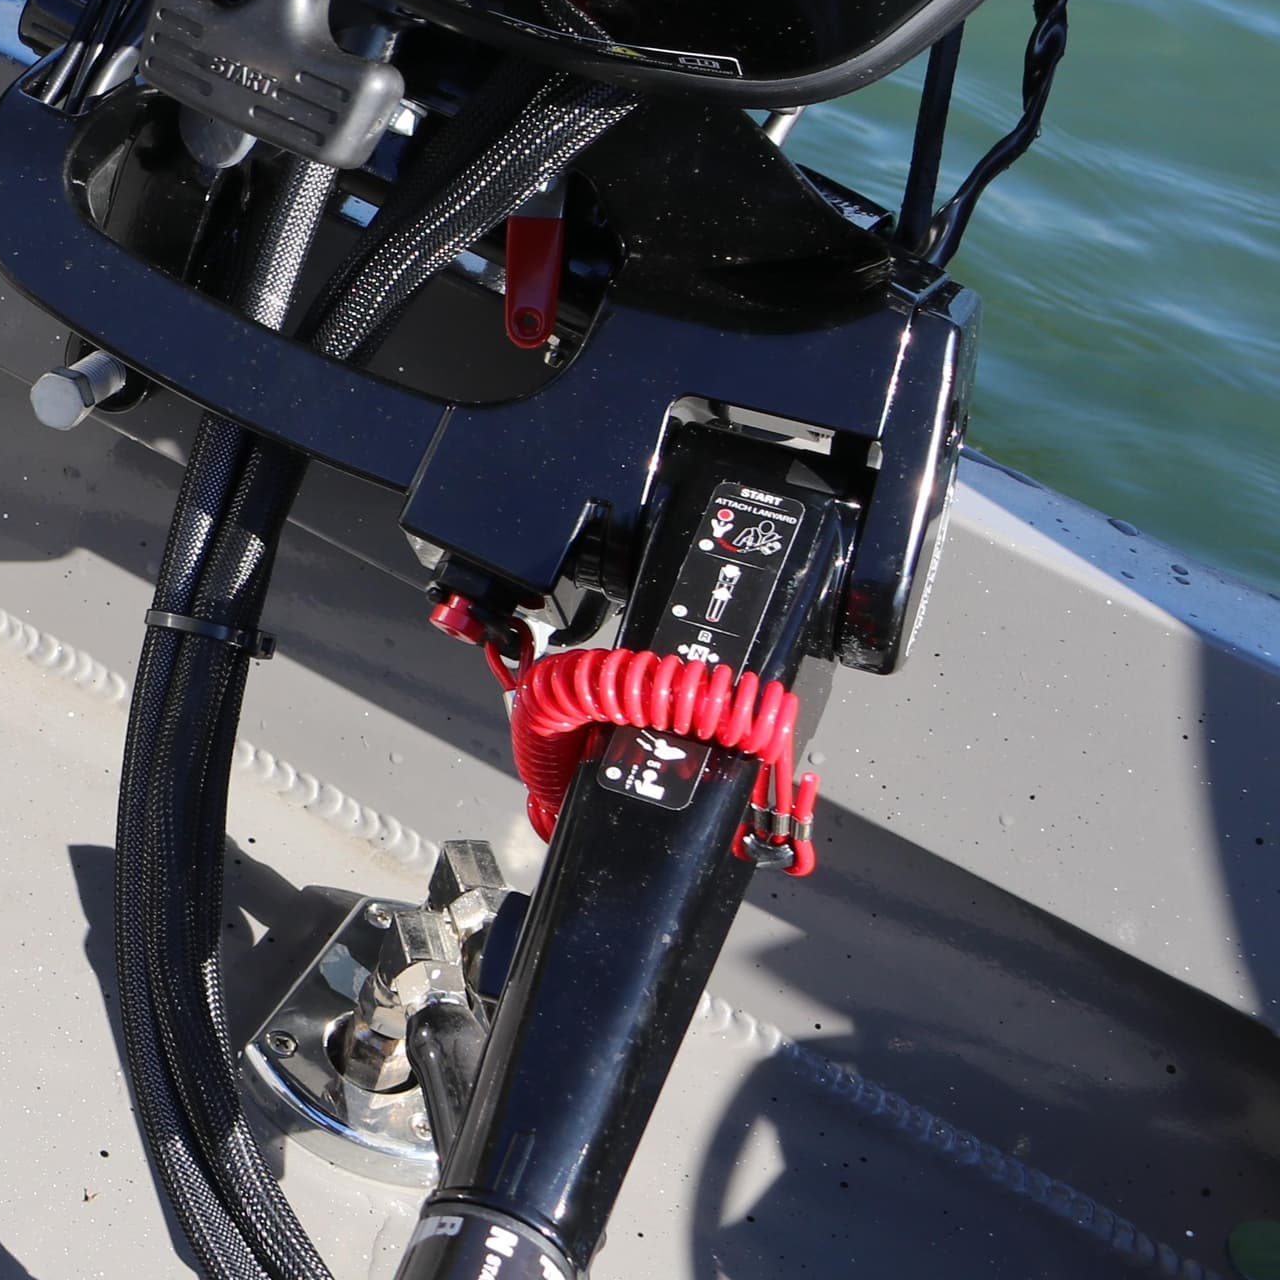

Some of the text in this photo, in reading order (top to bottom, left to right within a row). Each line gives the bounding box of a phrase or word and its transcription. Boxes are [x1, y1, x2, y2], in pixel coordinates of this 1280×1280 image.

[210, 56, 278, 95] START
[714, 497, 798, 526] ATTACH LANYARD
[740, 488, 783, 506] START
[697, 629, 713, 644] R
[485, 1225, 519, 1258] N
